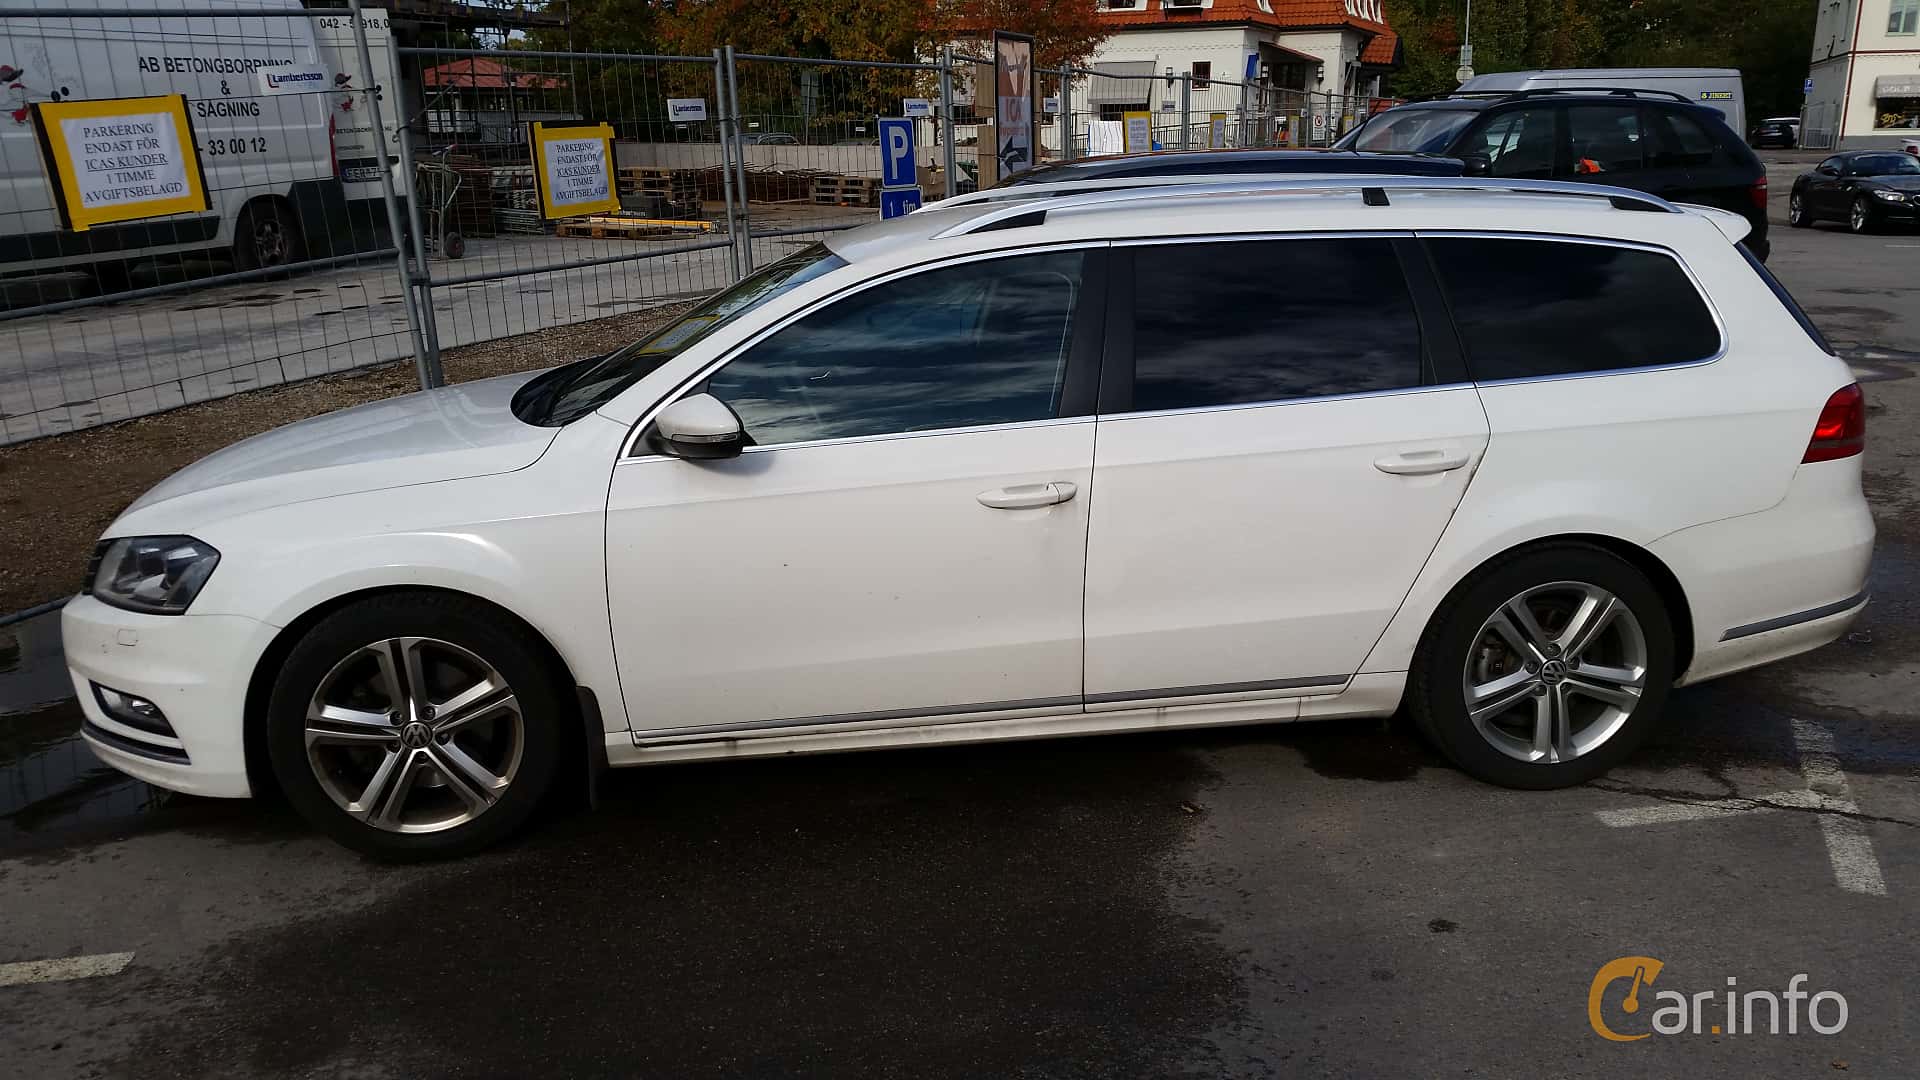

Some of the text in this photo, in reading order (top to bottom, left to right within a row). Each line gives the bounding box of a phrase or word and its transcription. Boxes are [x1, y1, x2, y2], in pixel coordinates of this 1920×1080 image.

[320, 18, 339, 29] 042
[139, 57, 160, 73] AB
[221, 80, 231, 95] &
[83, 123, 154, 138] PARKERING
[85, 138, 160, 154] ENDAST FÖR
[208, 139, 225, 156] 33
[230, 138, 246, 154] 00
[250, 137, 267, 153] 12
[556, 142, 594, 153] PARKERING
[888, 126, 908, 180] P
[85, 153, 168, 170] ICAS KUNDER
[557, 154, 583, 165] ENDAST
[116, 170, 157, 183] TIMME
[571, 177, 593, 186] TIMME
[84, 182, 184, 203] AVGIFTSBELAGD
[890, 200, 894, 217] 1
